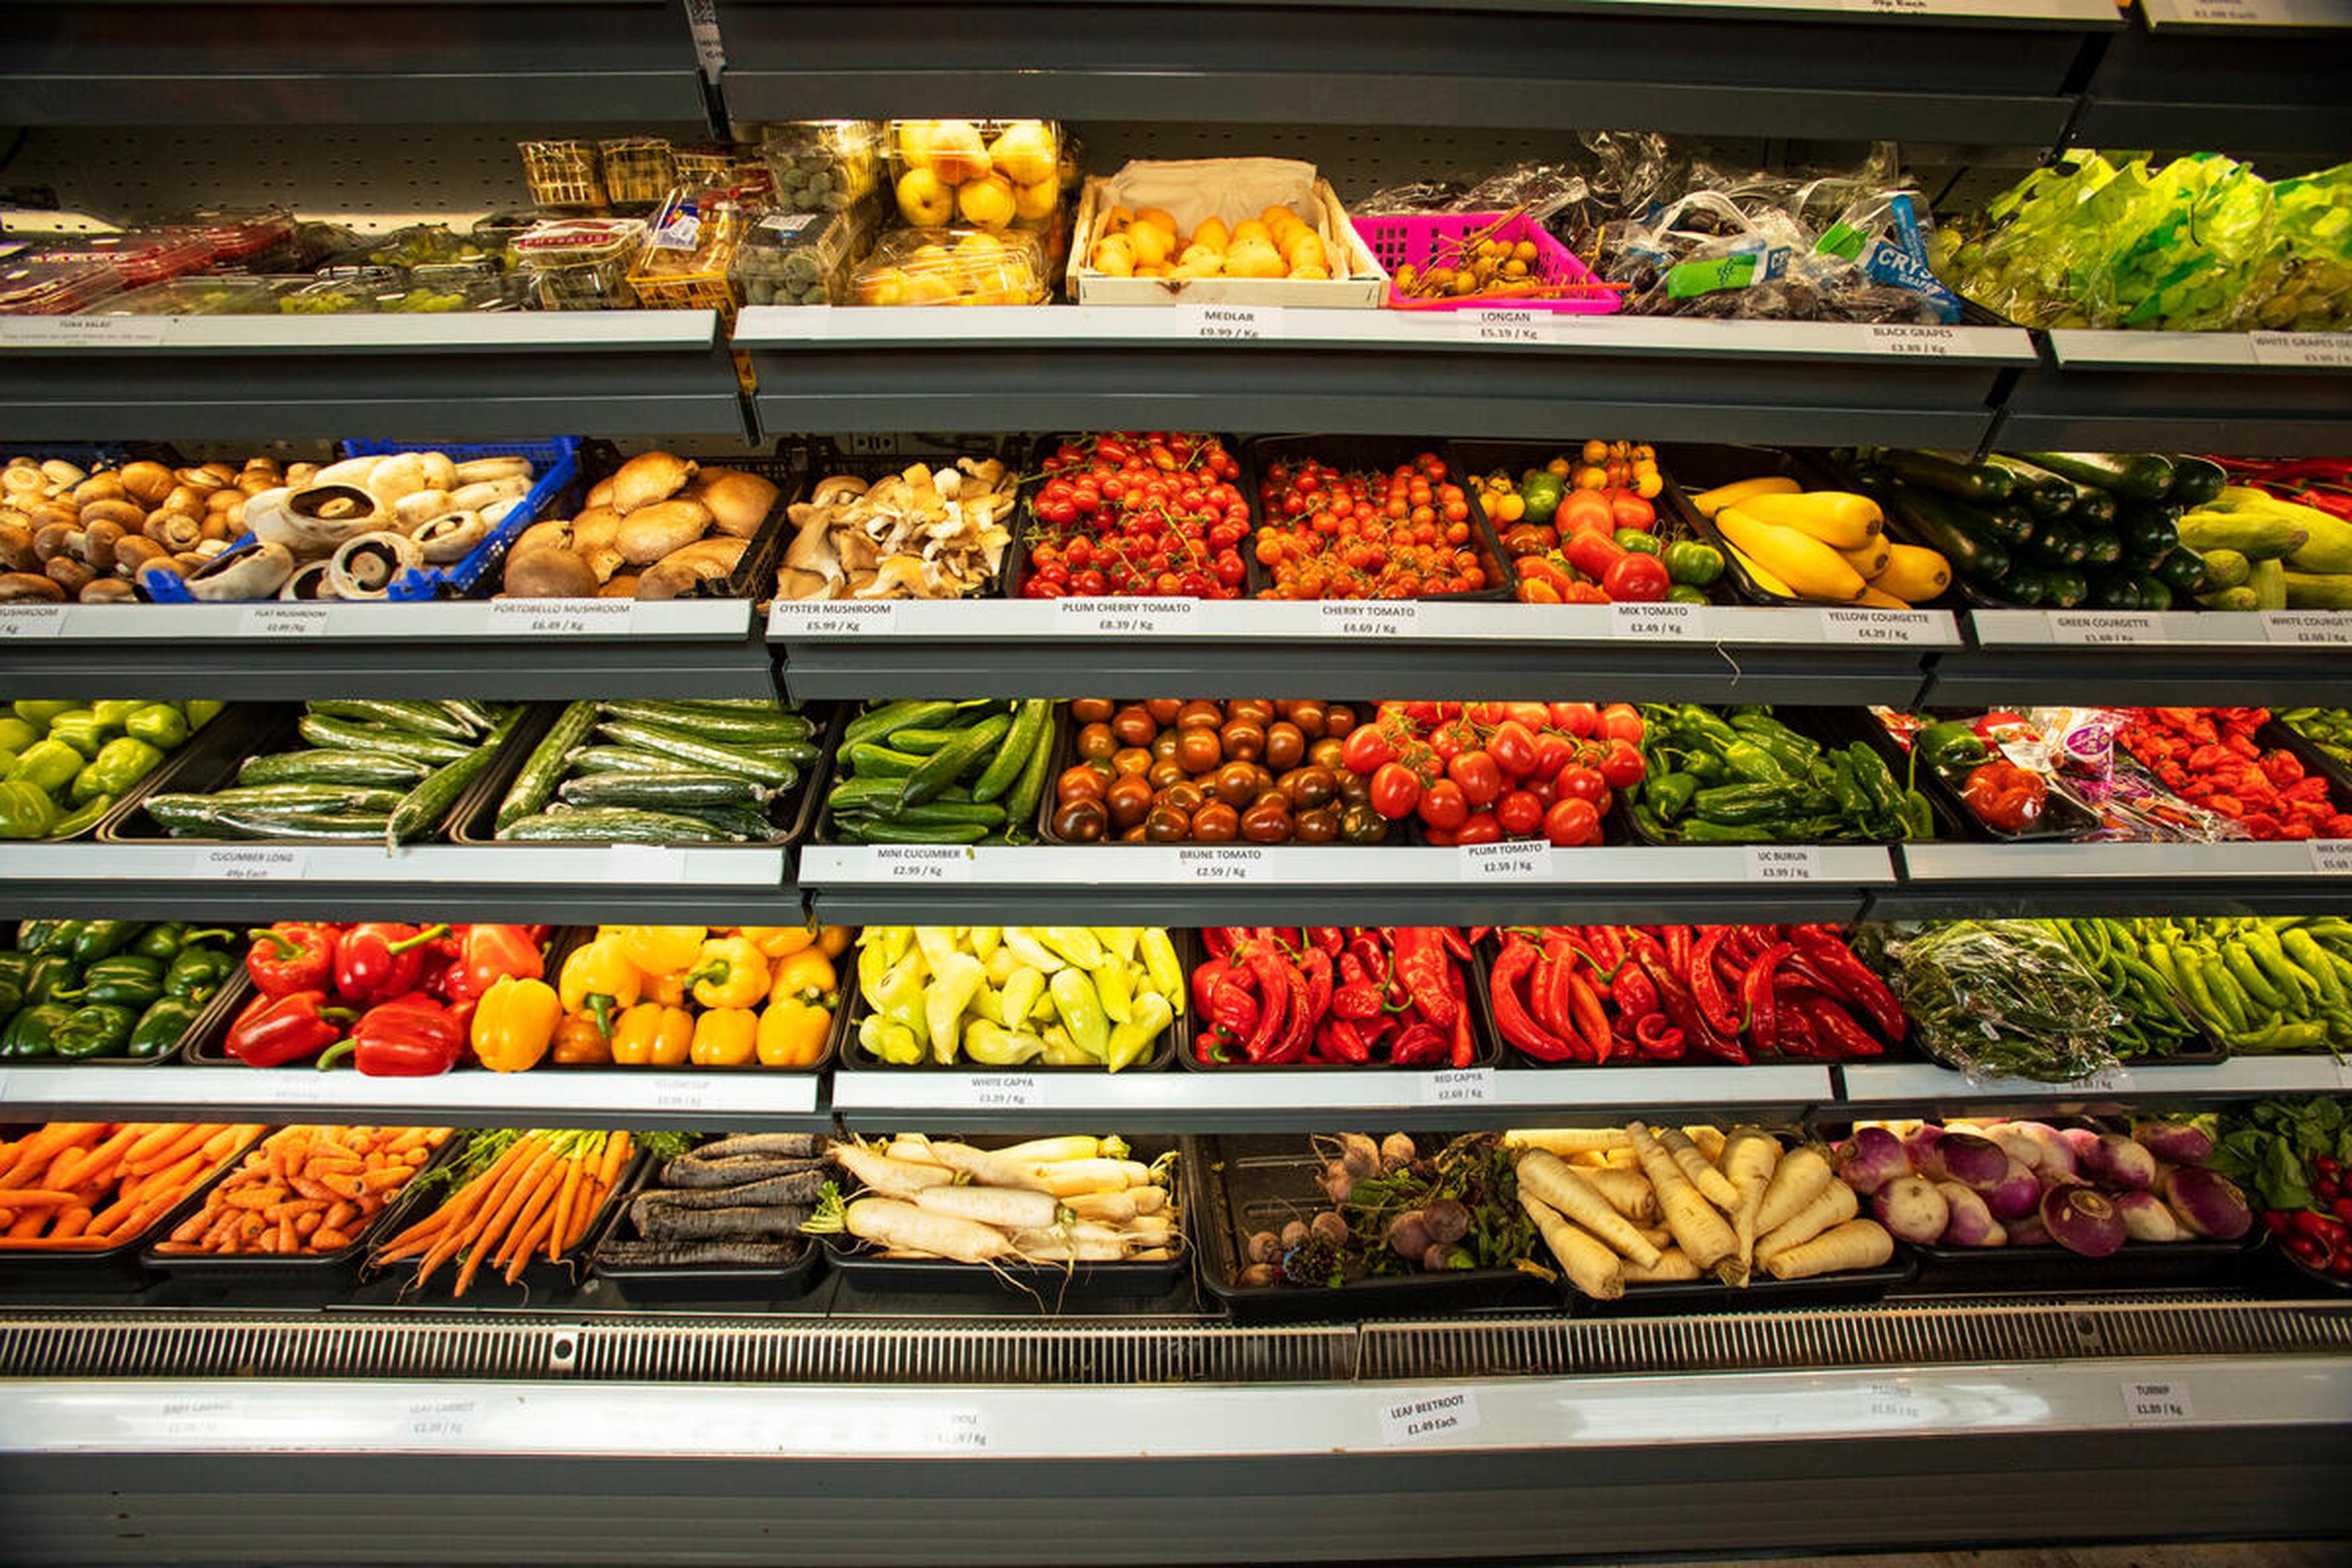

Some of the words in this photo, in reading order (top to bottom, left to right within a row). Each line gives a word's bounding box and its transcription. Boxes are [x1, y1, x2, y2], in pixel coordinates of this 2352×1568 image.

[1205, 311, 1254, 321] MEDLAR
[1482, 312, 1531, 322] LONGAN
[1873, 328, 1905, 336] BLACK
[1910, 329, 1953, 337] GRAPES
[493, 605, 561, 614] PORTOBELLO
[564, 605, 630, 614] MUSHROOM
[779, 605, 820, 614] OYSTER
[823, 605, 891, 614] MUSHROOM
[1061, 603, 1095, 612] PLUM
[1097, 603, 1139, 612] CHERRY
[1142, 603, 1191, 613] TOMATO
[1322, 606, 1364, 615] CHERRY
[1366, 607, 1415, 617] TOMATO
[1618, 606, 1640, 616] MIX
[1642, 606, 1689, 616] TOMATO
[1828, 611, 1869, 622] YELLOW
[1871, 612, 1929, 624] COURGETTE
[846, 622, 861, 631] Kg
[2057, 618, 2090, 627] GREEN
[2092, 619, 2149, 628] COURGETTE
[877, 850, 902, 858] MINI
[903, 849, 961, 859] CUCUMBER
[1180, 849, 1213, 859] BRUNE
[1217, 849, 1262, 859] TOMATO
[1469, 846, 1497, 858] PLUM
[1500, 843, 1542, 853] TOMATO
[209, 852, 264, 862] CUCUMBER
[266, 853, 294, 862] LONG
[971, 1077, 1001, 1086] WHITE
[1434, 1074, 1453, 1083] RED
[1391, 1404, 1412, 1419] LEAF
[1415, 1394, 1464, 1414] BEETROOT
[1435, 1415, 1458, 1430] Each
